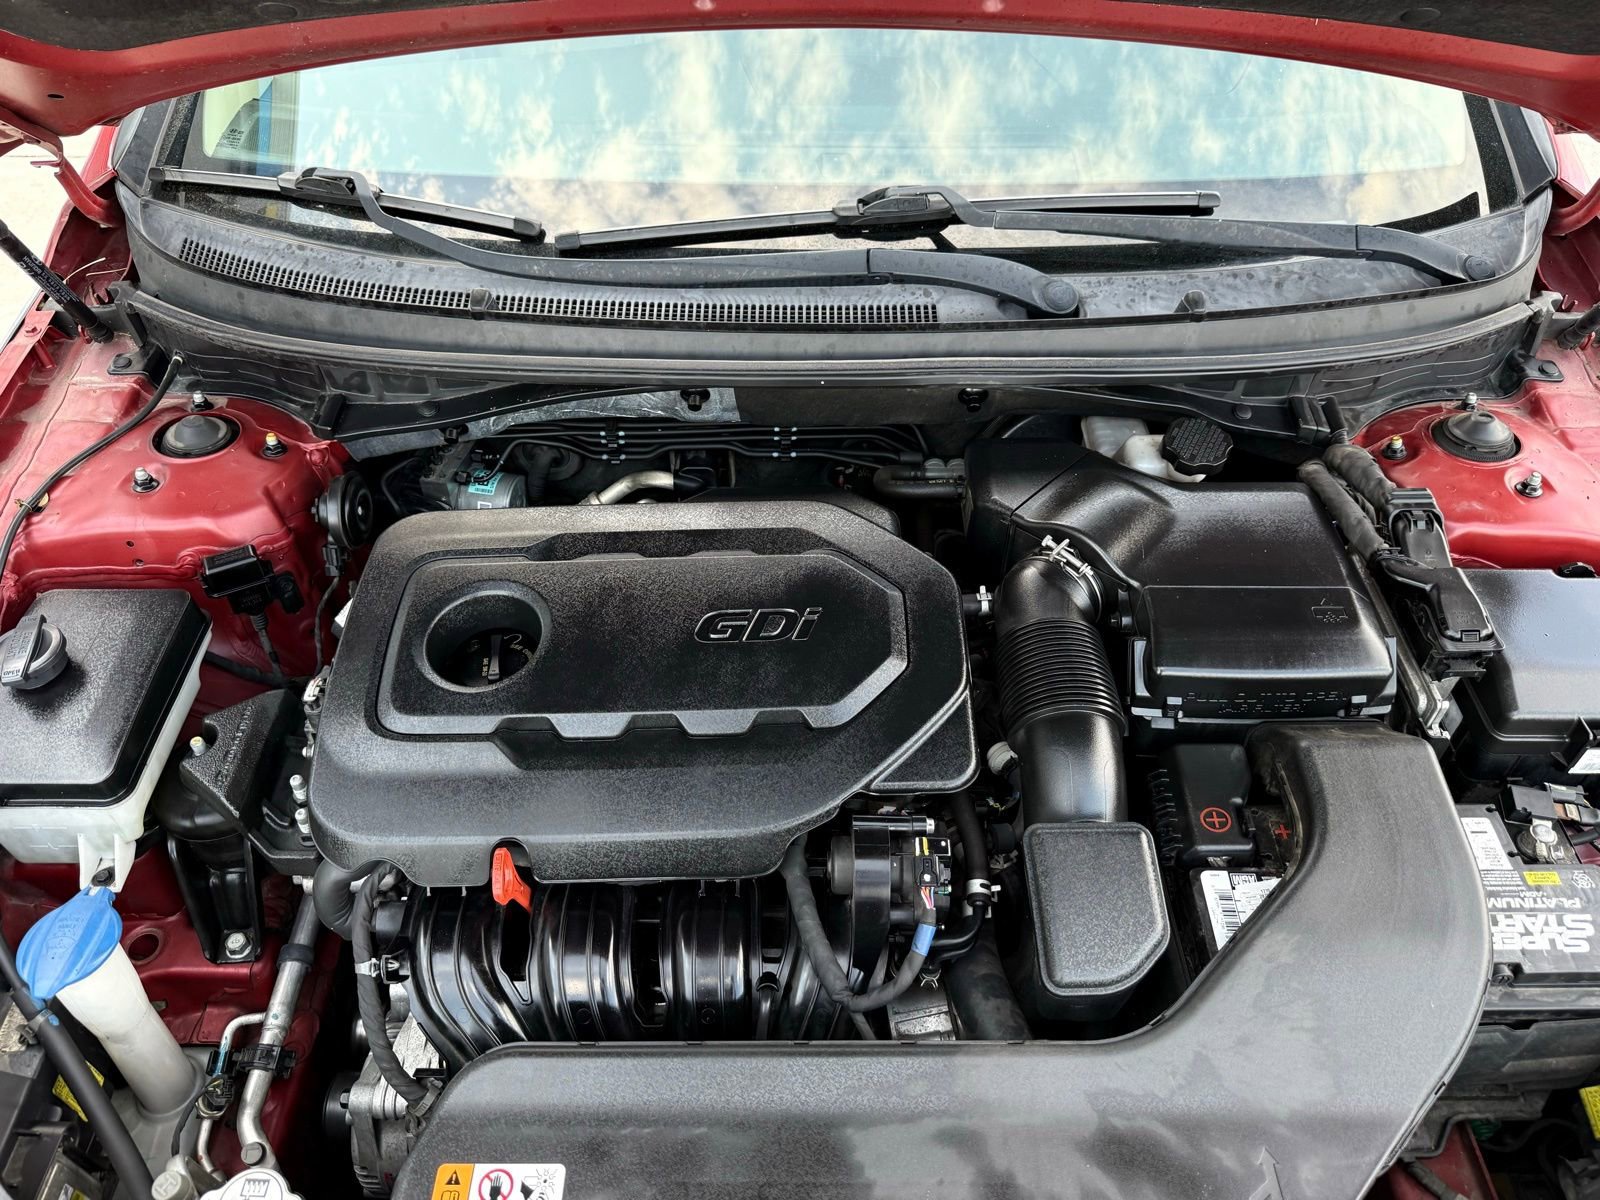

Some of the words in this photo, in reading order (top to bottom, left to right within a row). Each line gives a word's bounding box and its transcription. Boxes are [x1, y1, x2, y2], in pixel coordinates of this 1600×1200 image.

[22, 256, 43, 274] HYUNDAI
[694, 605, 824, 645] GDi
[1232, 874, 1256, 886] AGM
[1487, 897, 1582, 909] PLATINUM
